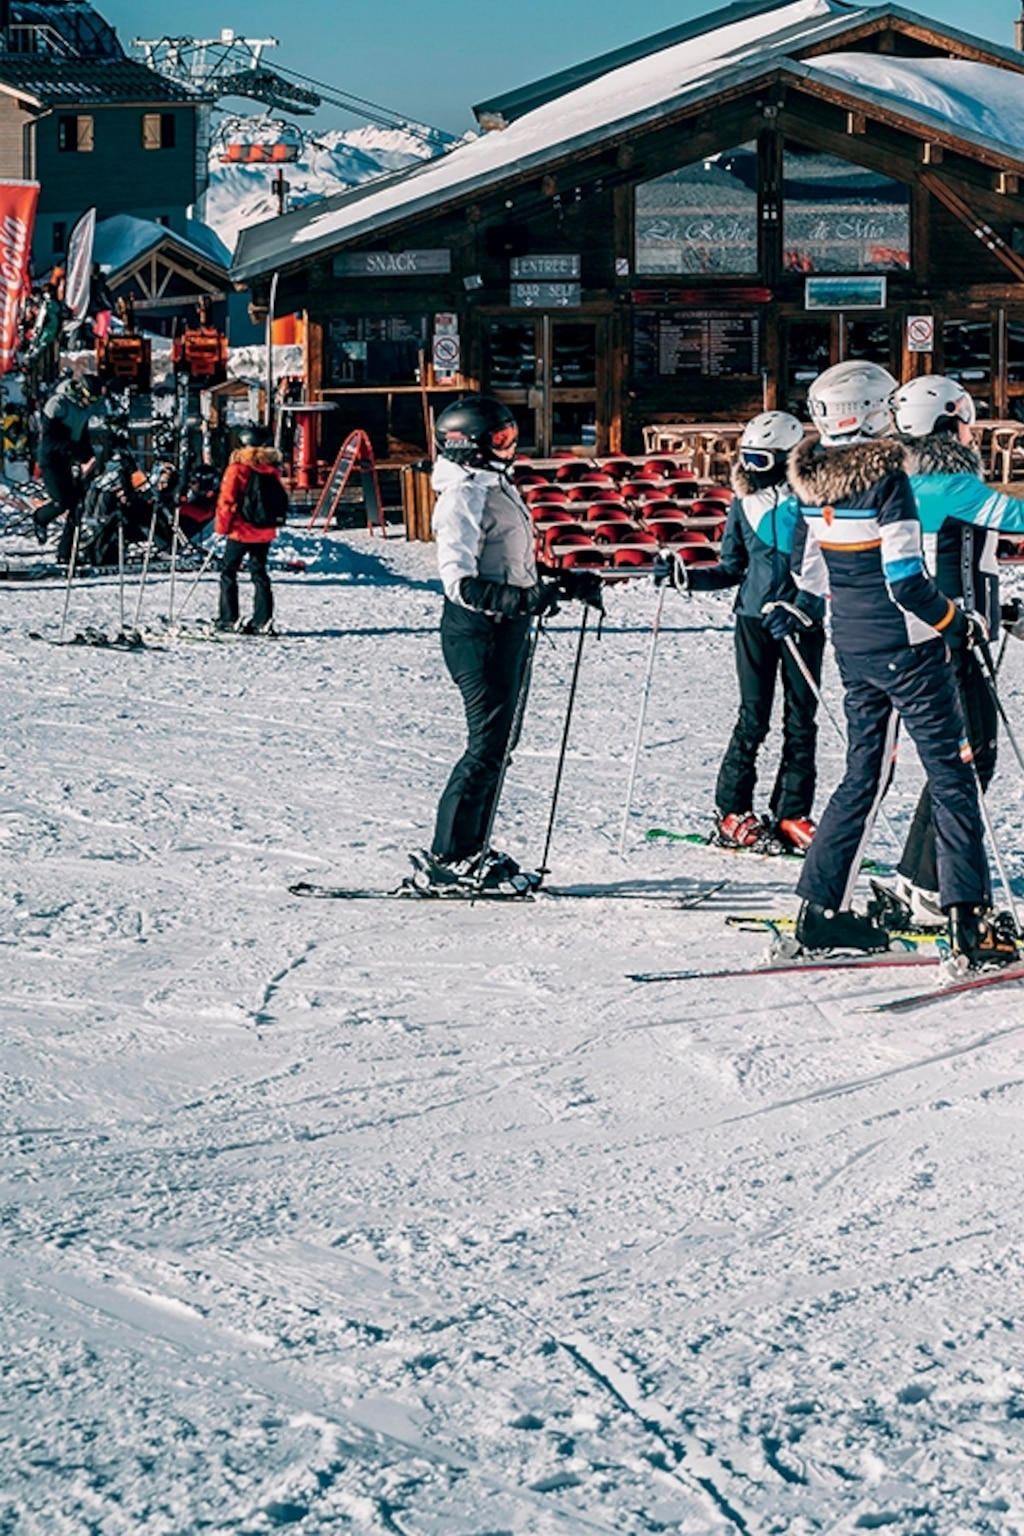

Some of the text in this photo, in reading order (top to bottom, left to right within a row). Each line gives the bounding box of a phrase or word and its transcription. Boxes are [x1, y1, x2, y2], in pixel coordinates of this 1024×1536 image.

[685, 219, 751, 241] Roche
[809, 219, 830, 240] de
[836, 219, 884, 241] Mio
[366, 253, 417, 272] SNACK
[517, 284, 575, 298] BAR SELF
